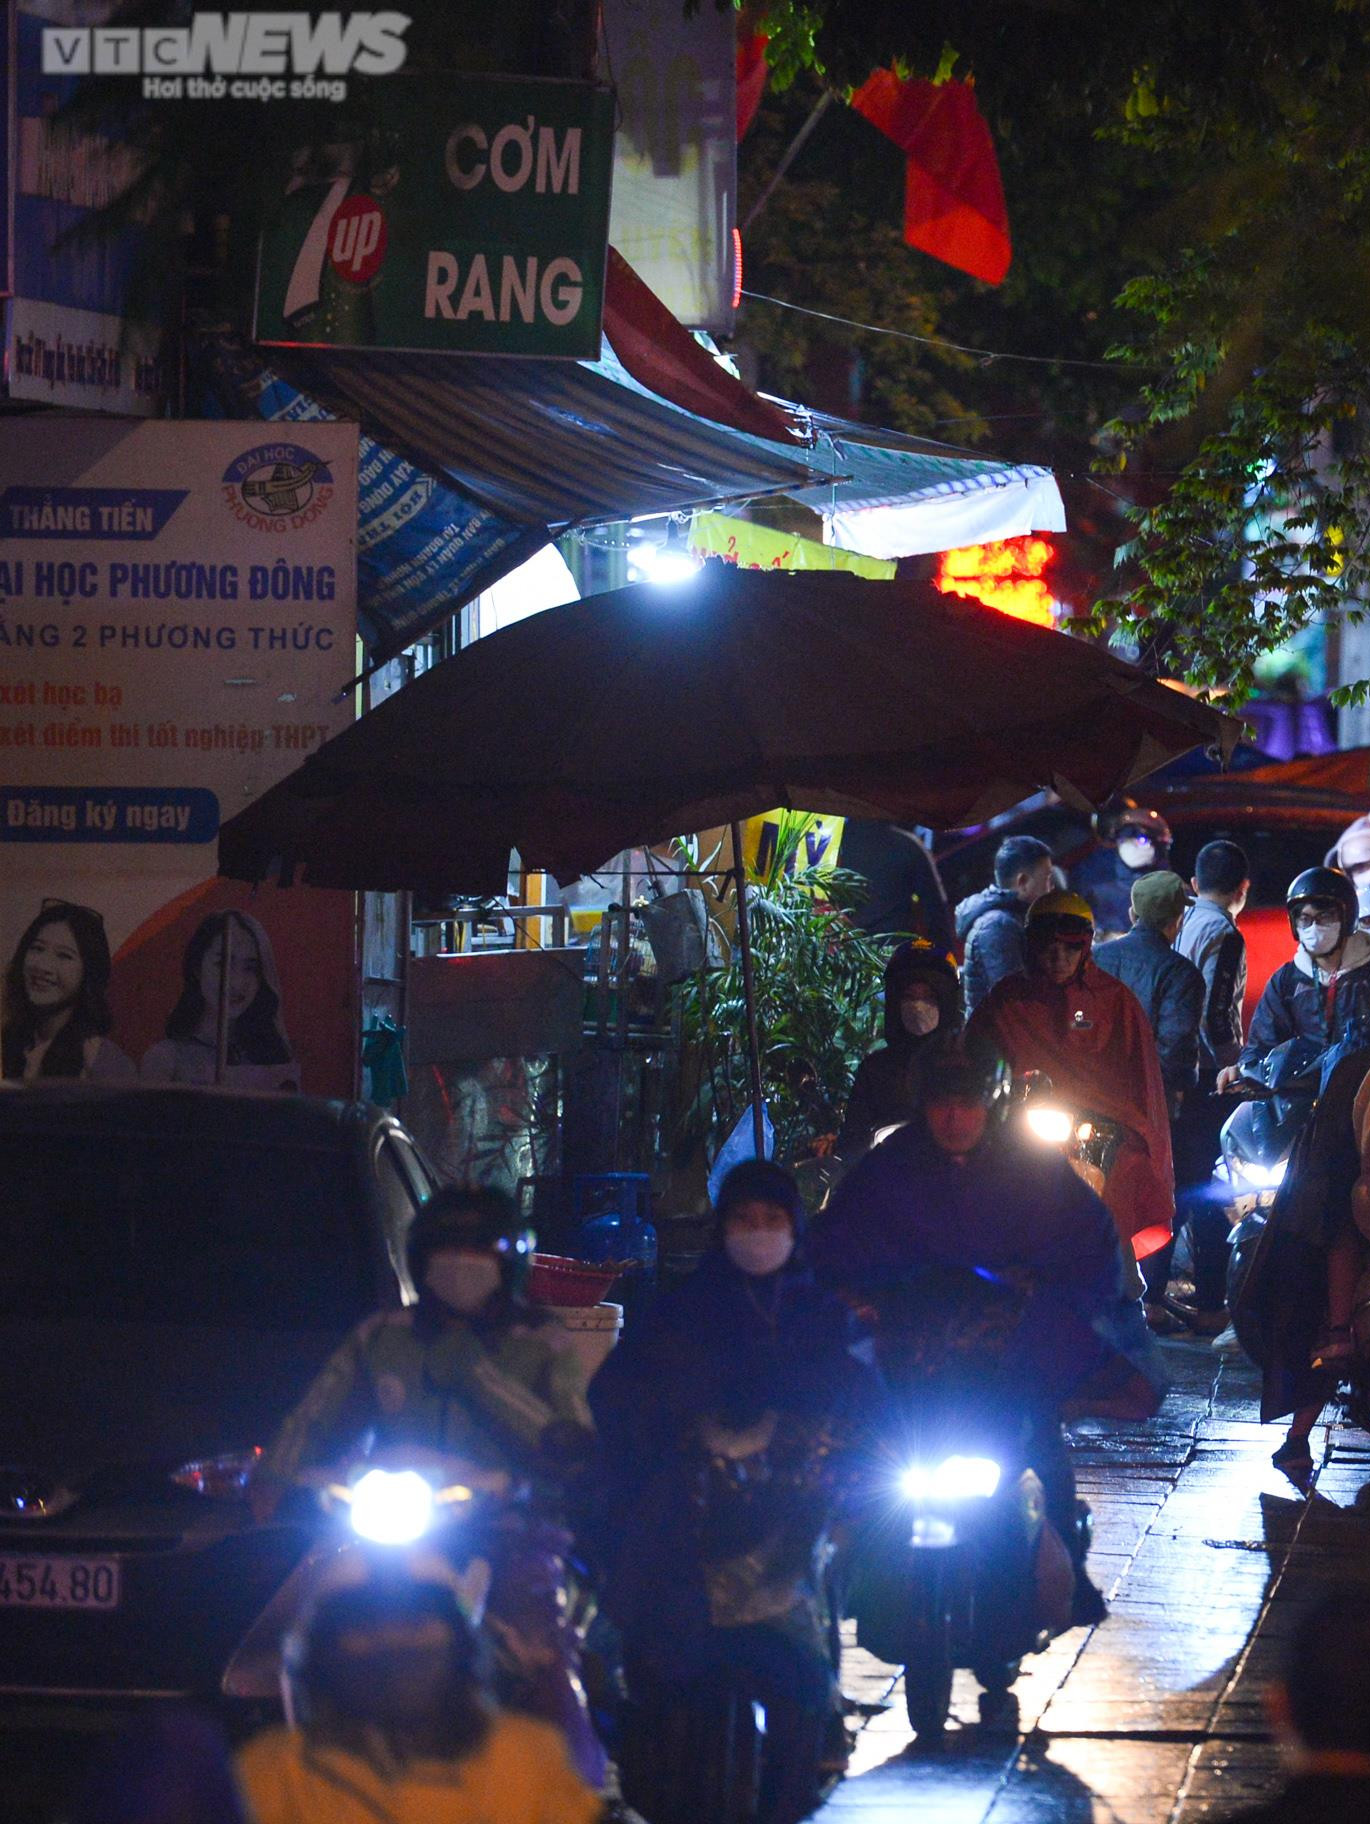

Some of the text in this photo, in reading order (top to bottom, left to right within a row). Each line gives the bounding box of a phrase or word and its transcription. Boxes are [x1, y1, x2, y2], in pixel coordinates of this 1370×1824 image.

[445, 114, 582, 195] CƠM
[424, 250, 583, 326] RANG
[35, 561, 98, 605] HỌC
[109, 560, 239, 600] PHƯƠNG
[249, 558, 336, 600] ĐÔNG
[72, 625, 87, 648] 2
[100, 623, 237, 649] PHƯƠNG
[248, 622, 335, 650] THỨC
[272, 725, 330, 749] THPT
[85, 799, 117, 832] ký
[126, 805, 191, 832] ngay
